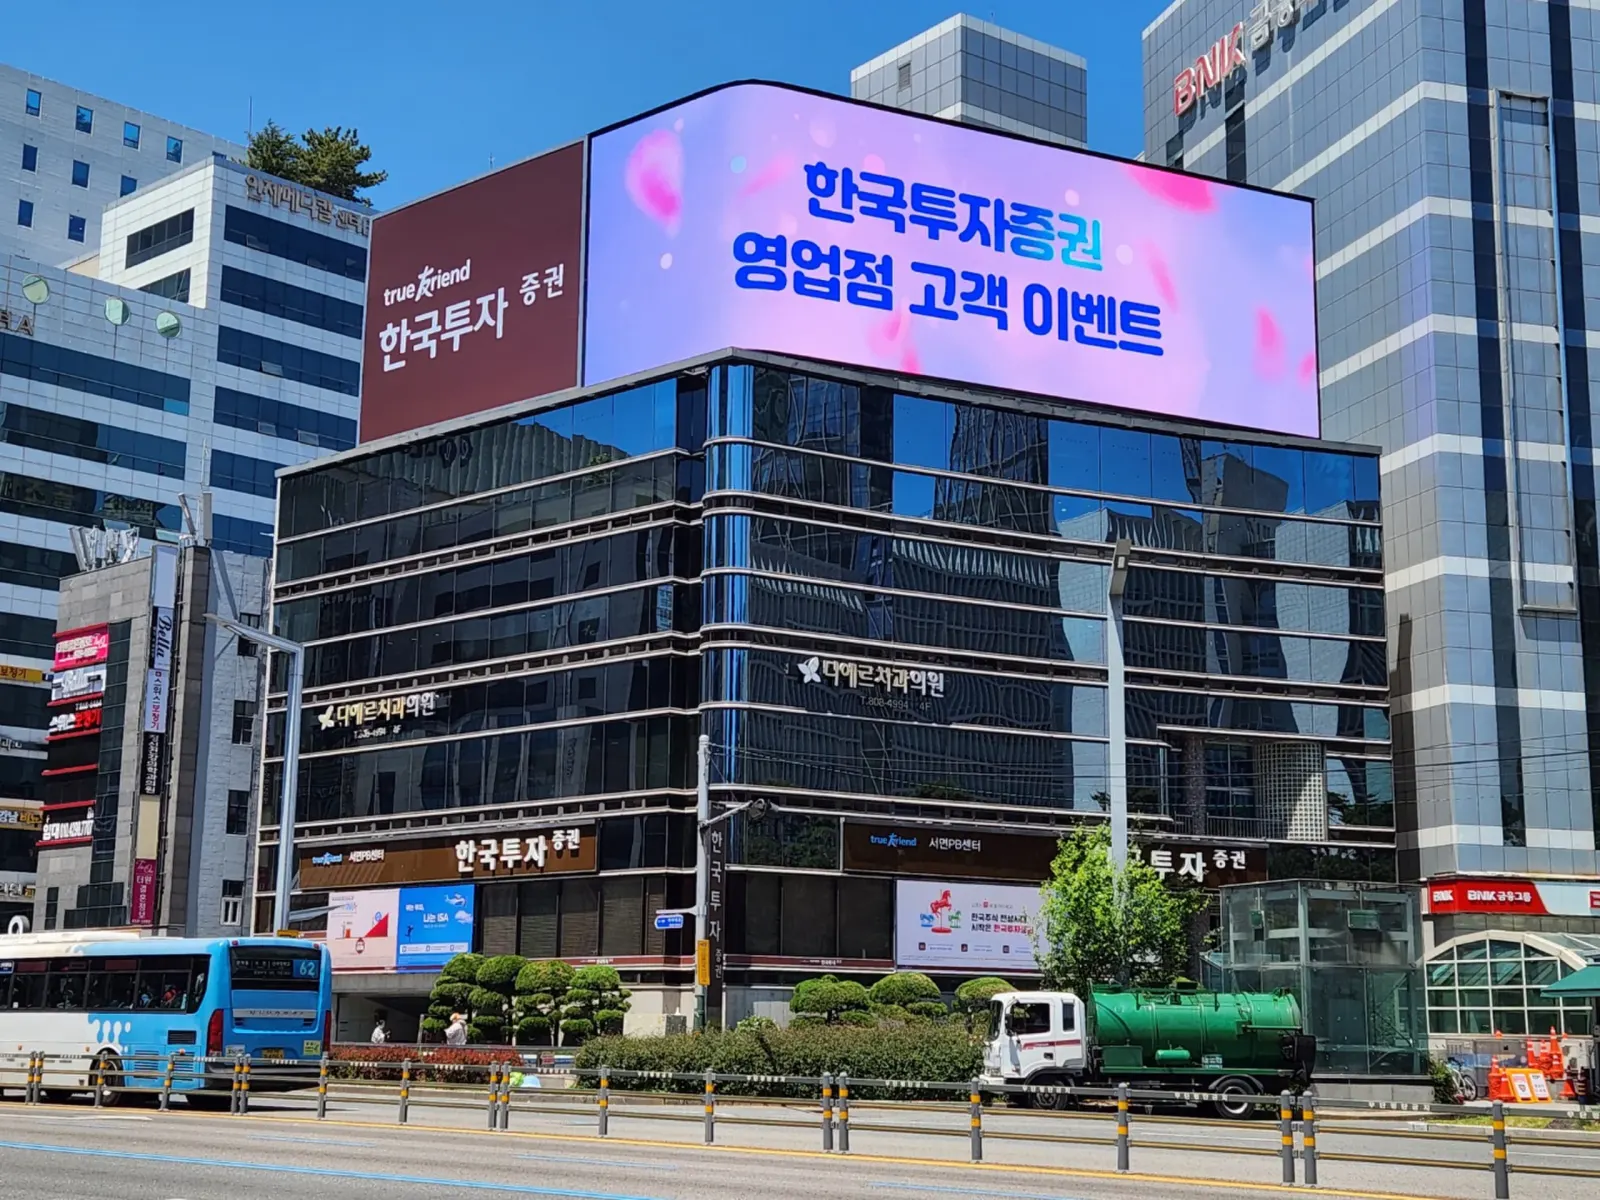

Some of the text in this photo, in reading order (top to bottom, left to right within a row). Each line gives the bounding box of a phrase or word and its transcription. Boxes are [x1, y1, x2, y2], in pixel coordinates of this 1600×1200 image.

[1173, 21, 1246, 117] BNK
[804, 161, 1103, 272] 한국투자증권
[733, 231, 1164, 357] 영업점 고객 이벤트
[379, 263, 565, 372] 한국투자 증권
[156, 615, 172, 658] Bella
[455, 828, 580, 872] 한국투자 증권
[928, 837, 981, 852] 서면PB센터
[1212, 849, 1246, 870] 증권
[1432, 889, 1454, 902] BNK
[299, 959, 316, 977] 62
